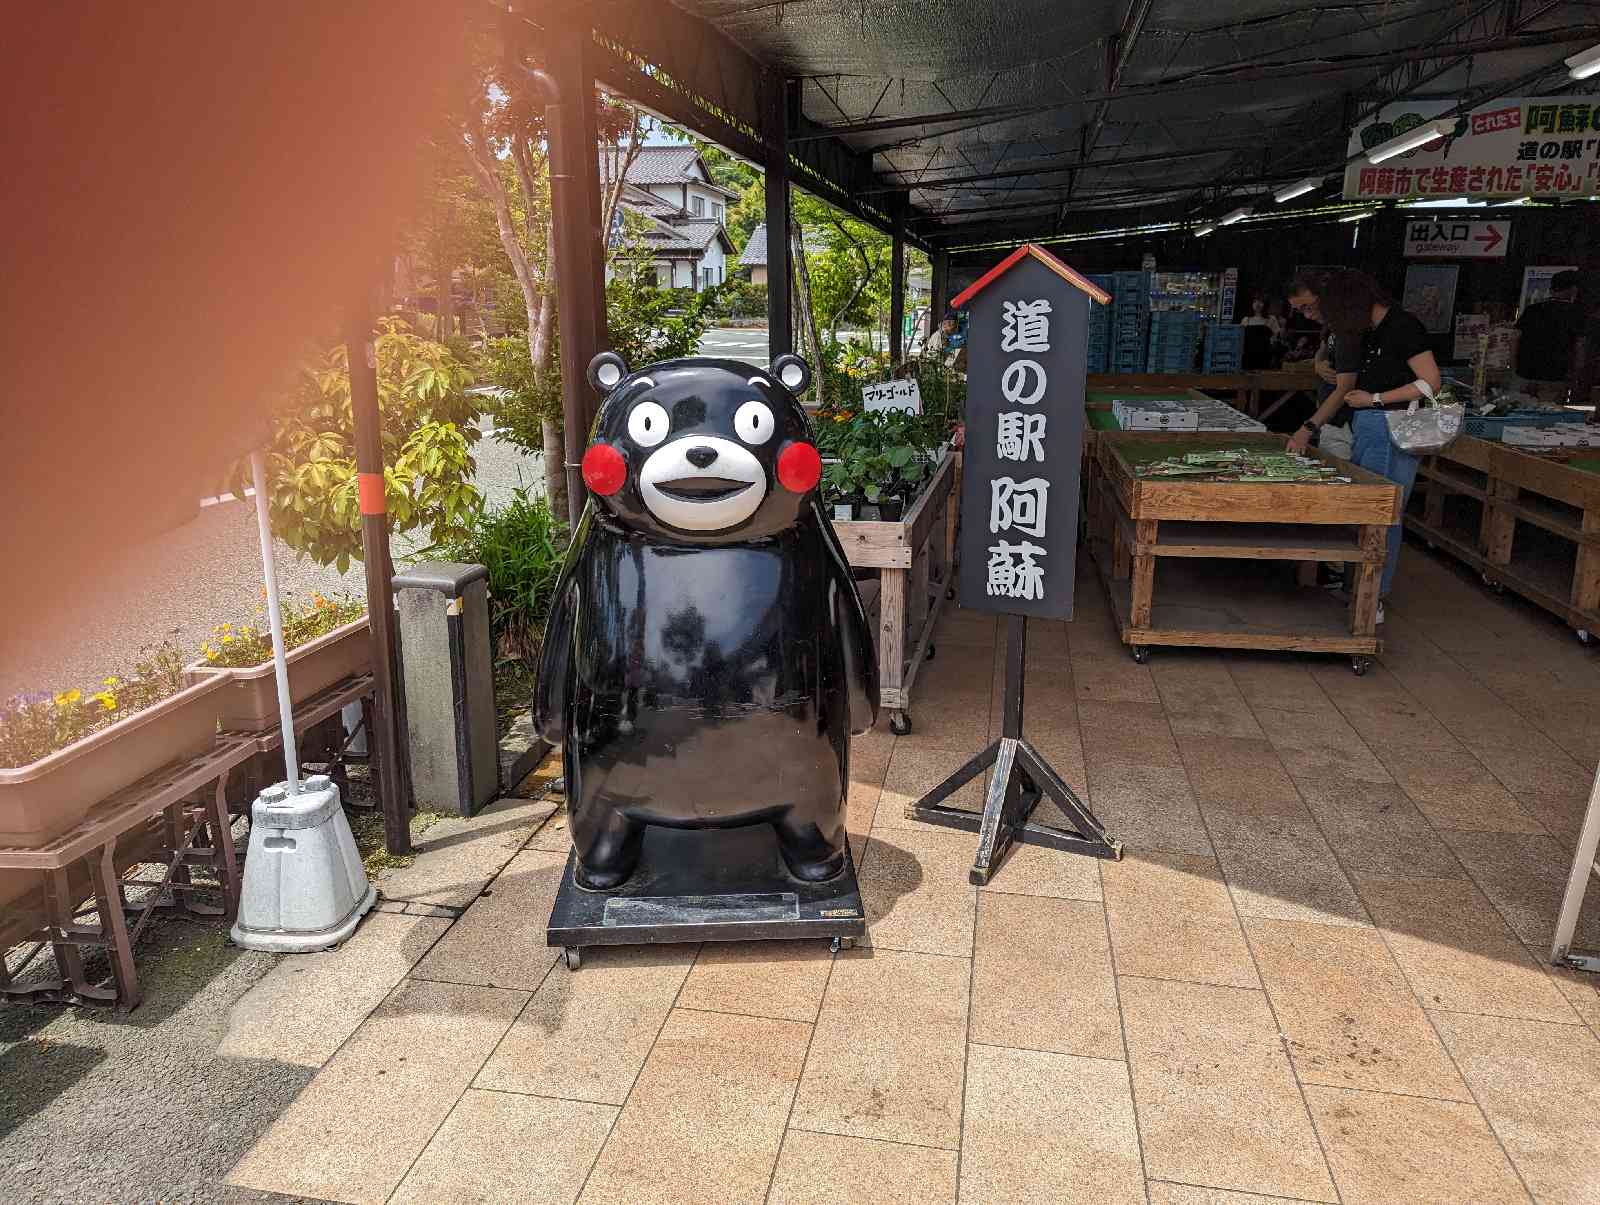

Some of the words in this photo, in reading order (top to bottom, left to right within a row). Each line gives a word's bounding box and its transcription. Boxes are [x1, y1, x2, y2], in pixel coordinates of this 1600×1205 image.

[1525, 104, 1600, 134] 阿蘇
[1517, 139, 1600, 160] 道の駅「
[1359, 161, 1600, 195] 阿蘇市で生産された「安心」「
[1410, 224, 1469, 241] 出入口
[864, 383, 916, 401] マリーゴールド
